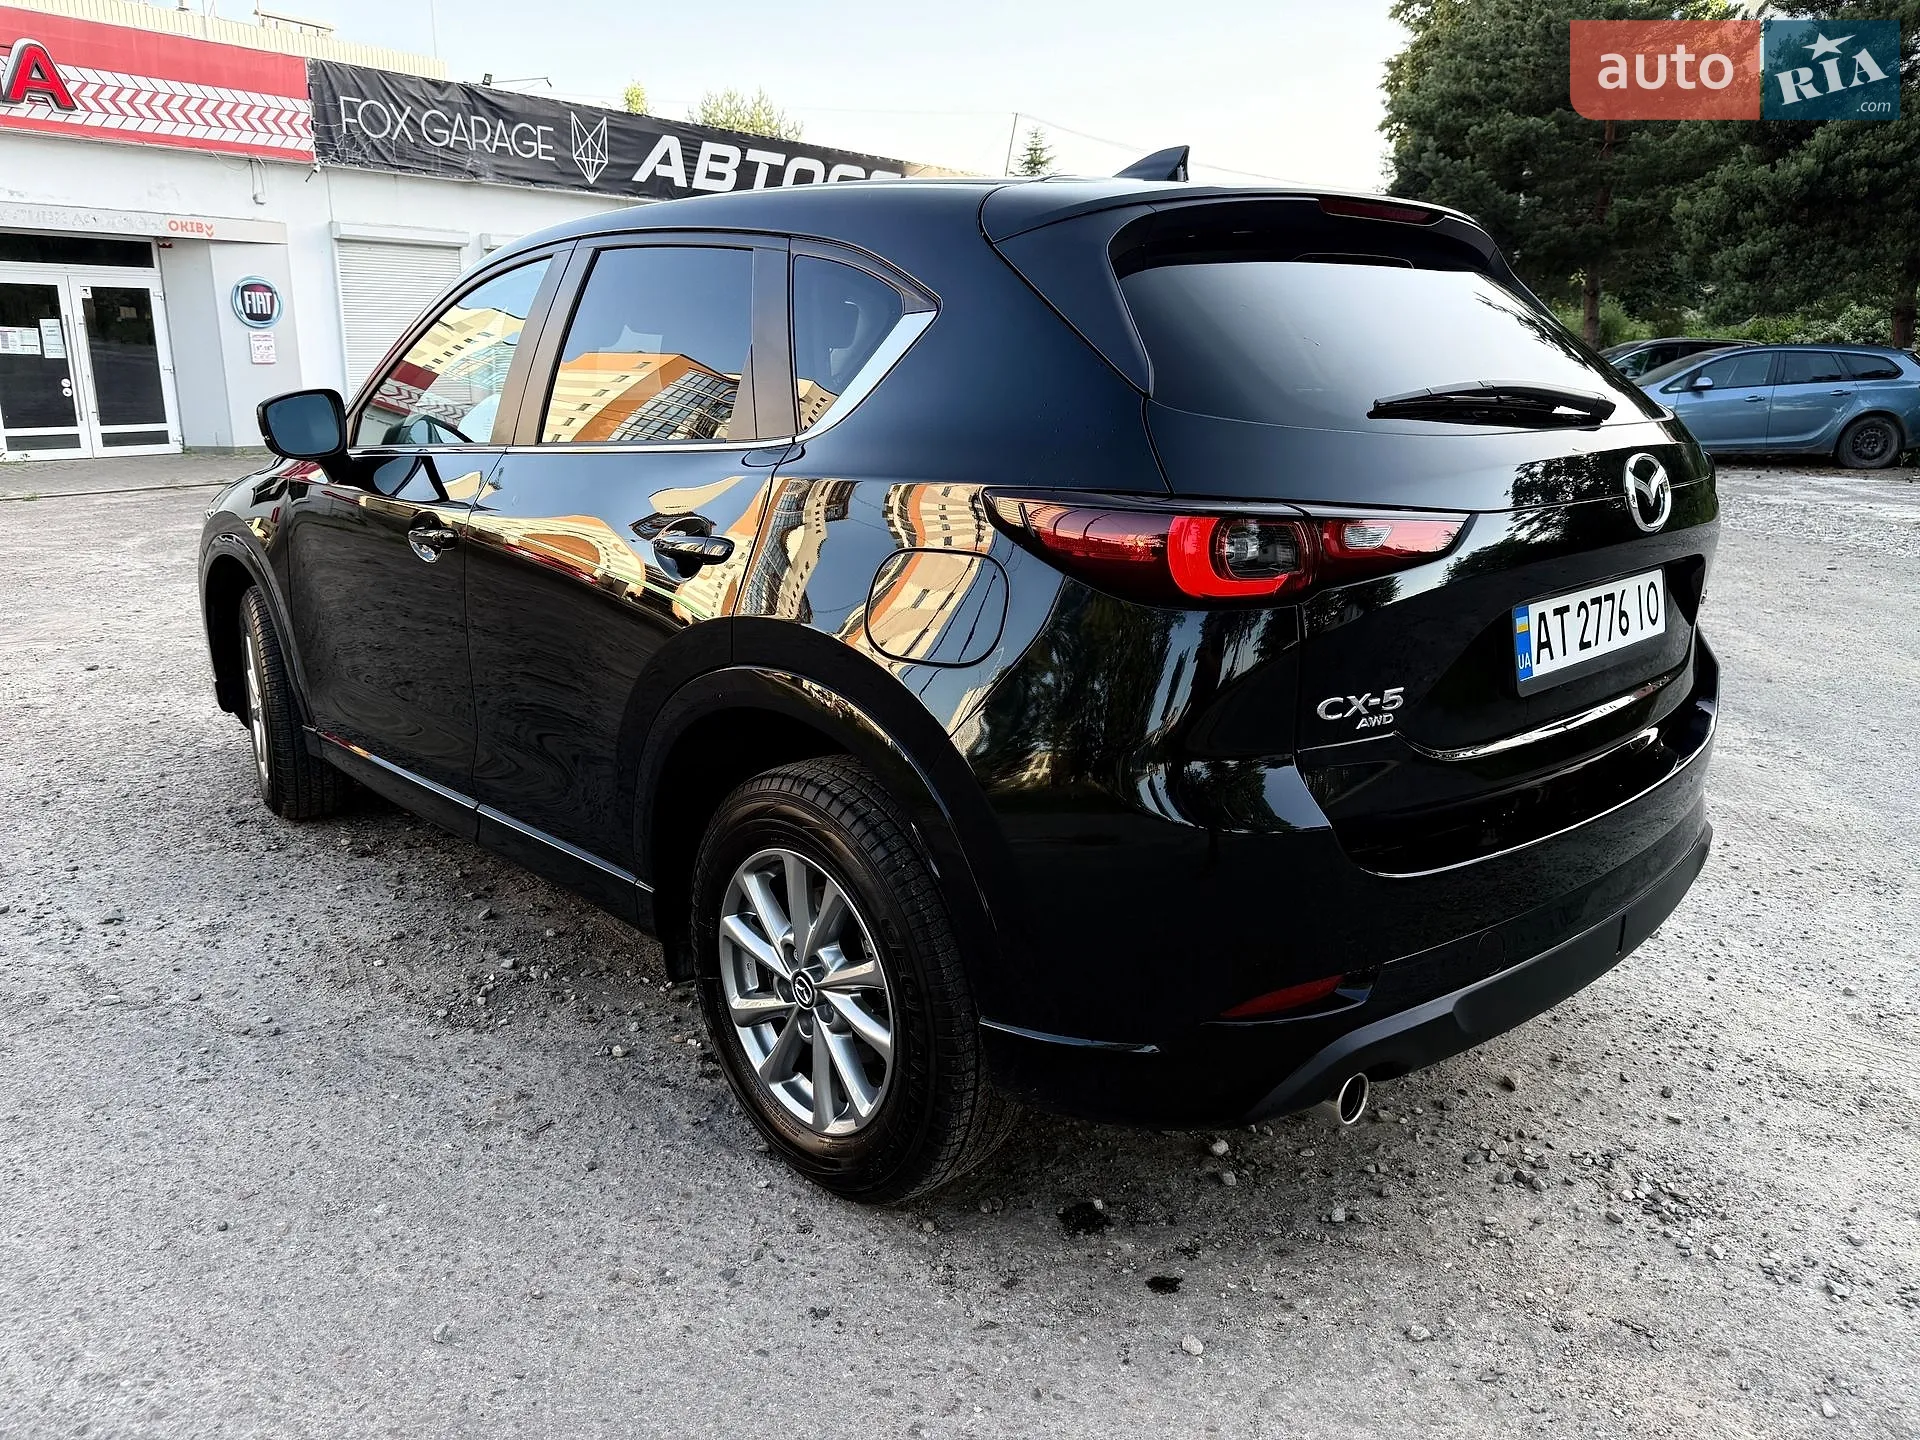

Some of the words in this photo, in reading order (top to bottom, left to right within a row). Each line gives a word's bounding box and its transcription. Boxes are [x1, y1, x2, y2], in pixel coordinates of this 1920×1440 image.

[339, 95, 415, 144] FOX
[420, 109, 556, 161] GARAGE
[243, 290, 273, 315] FIAT
[1536, 604, 1570, 665] AT
[1577, 590, 1630, 651] 2776
[1637, 581, 1660, 630] IO
[1518, 652, 1531, 670] UA
[1316, 687, 1405, 721] CX-5
[1355, 713, 1394, 730] AWD
